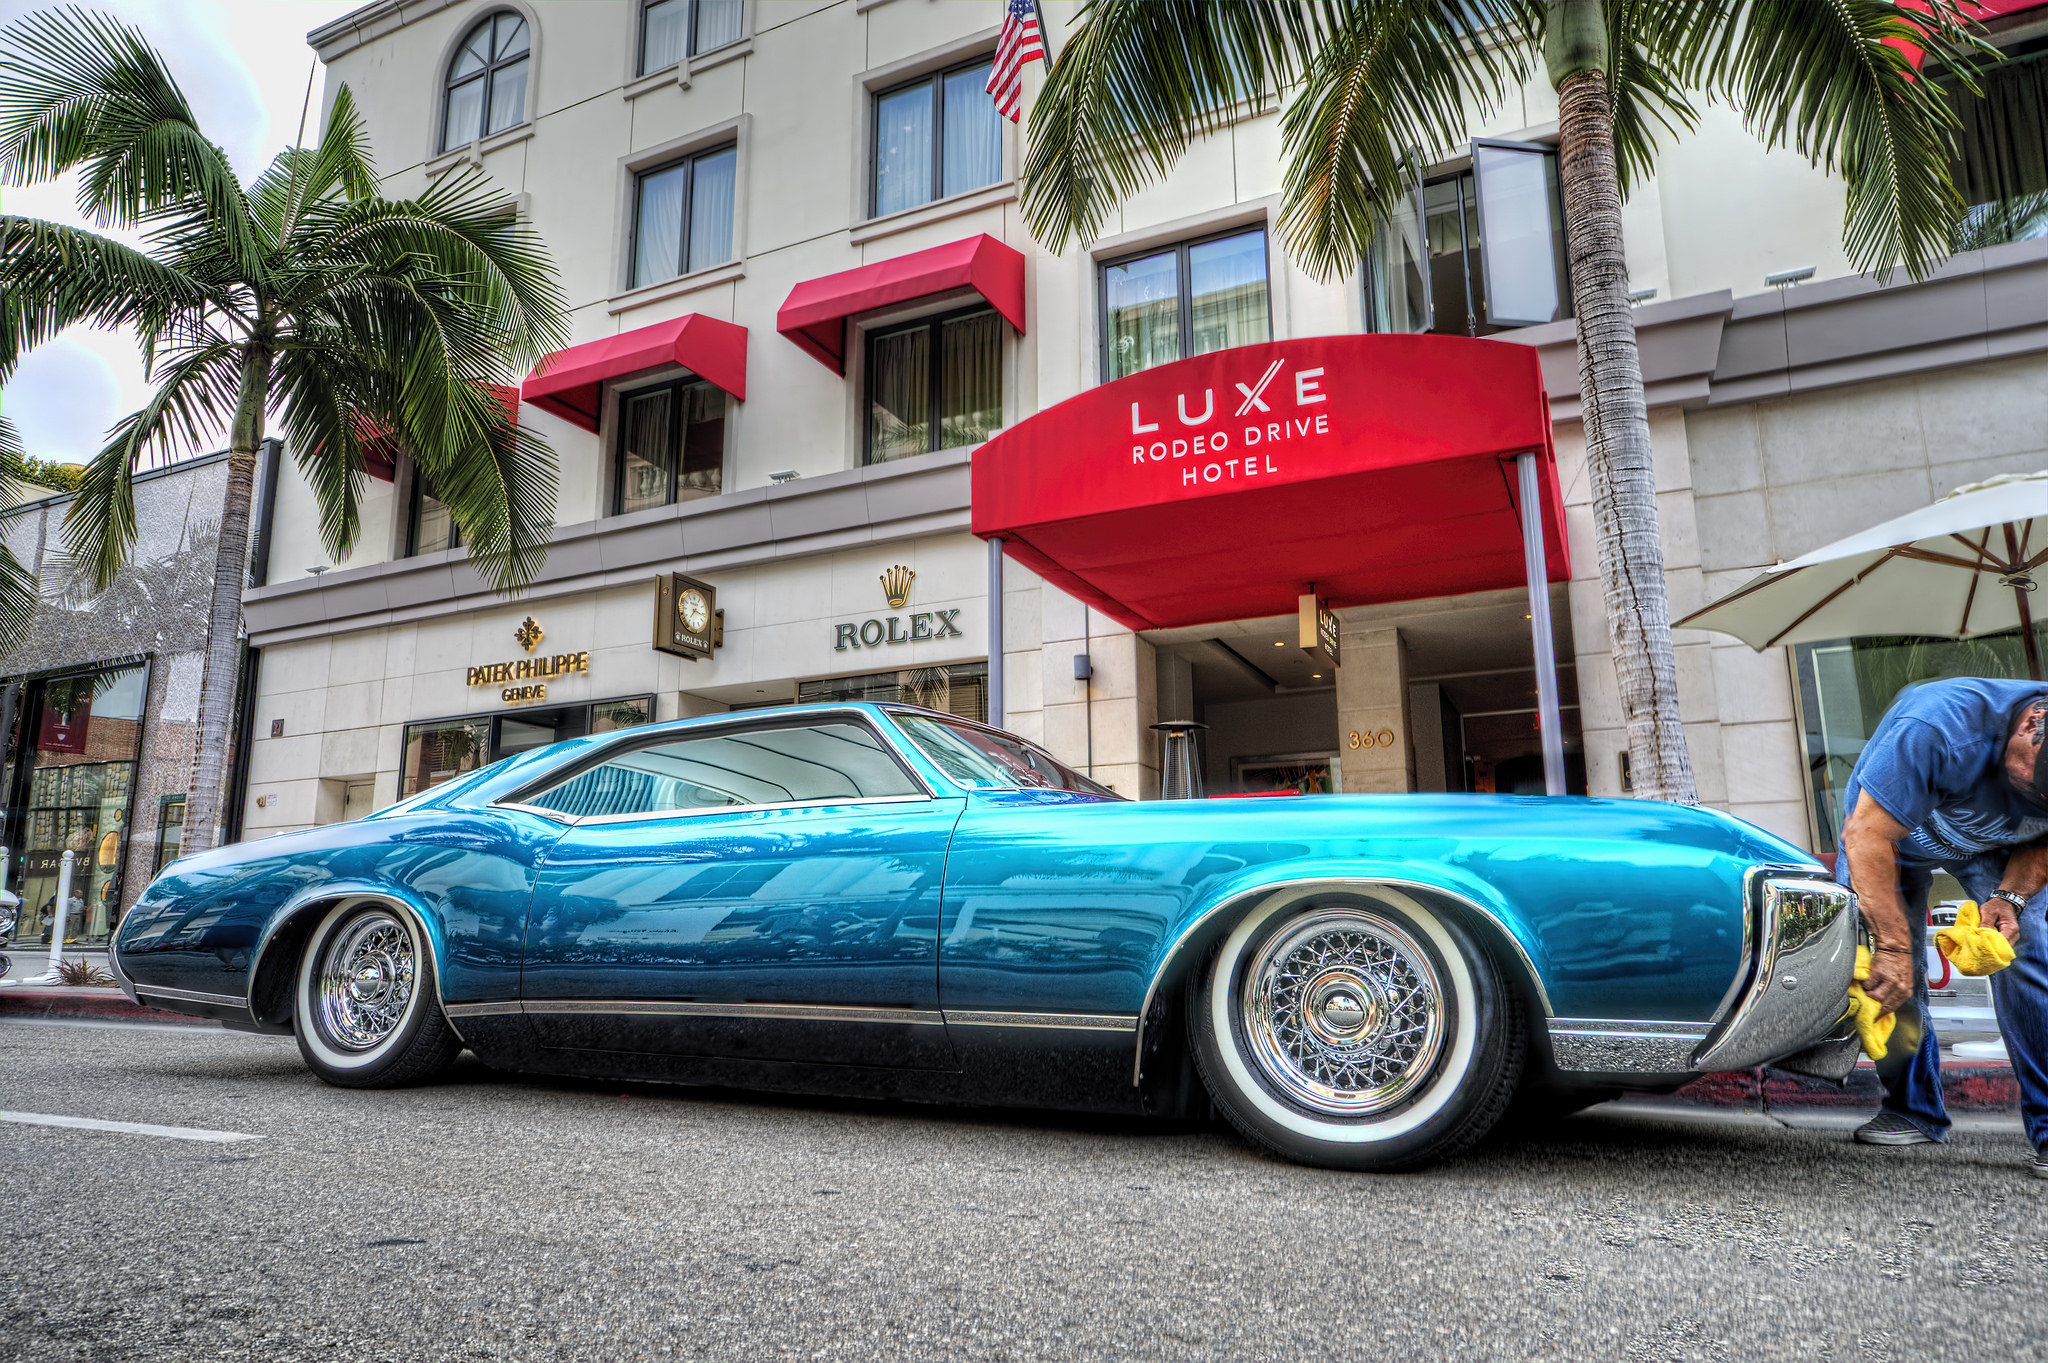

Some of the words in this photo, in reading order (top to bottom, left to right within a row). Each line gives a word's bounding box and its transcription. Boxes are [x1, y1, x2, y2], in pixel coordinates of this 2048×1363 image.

[1131, 358, 1327, 435] LUXE
[1132, 431, 1229, 465] RODEO
[1245, 414, 1329, 446] DRIVE
[1183, 454, 1278, 486] HOTEL
[834, 608, 962, 651] ROLEX
[1319, 609, 1337, 638] LUXE
[681, 634, 703, 647] ROLEX
[466, 661, 514, 686] PATEK
[516, 651, 589, 680] PHILIPPE
[501, 684, 545, 701] GENEVE
[1349, 729, 1394, 750] 360
